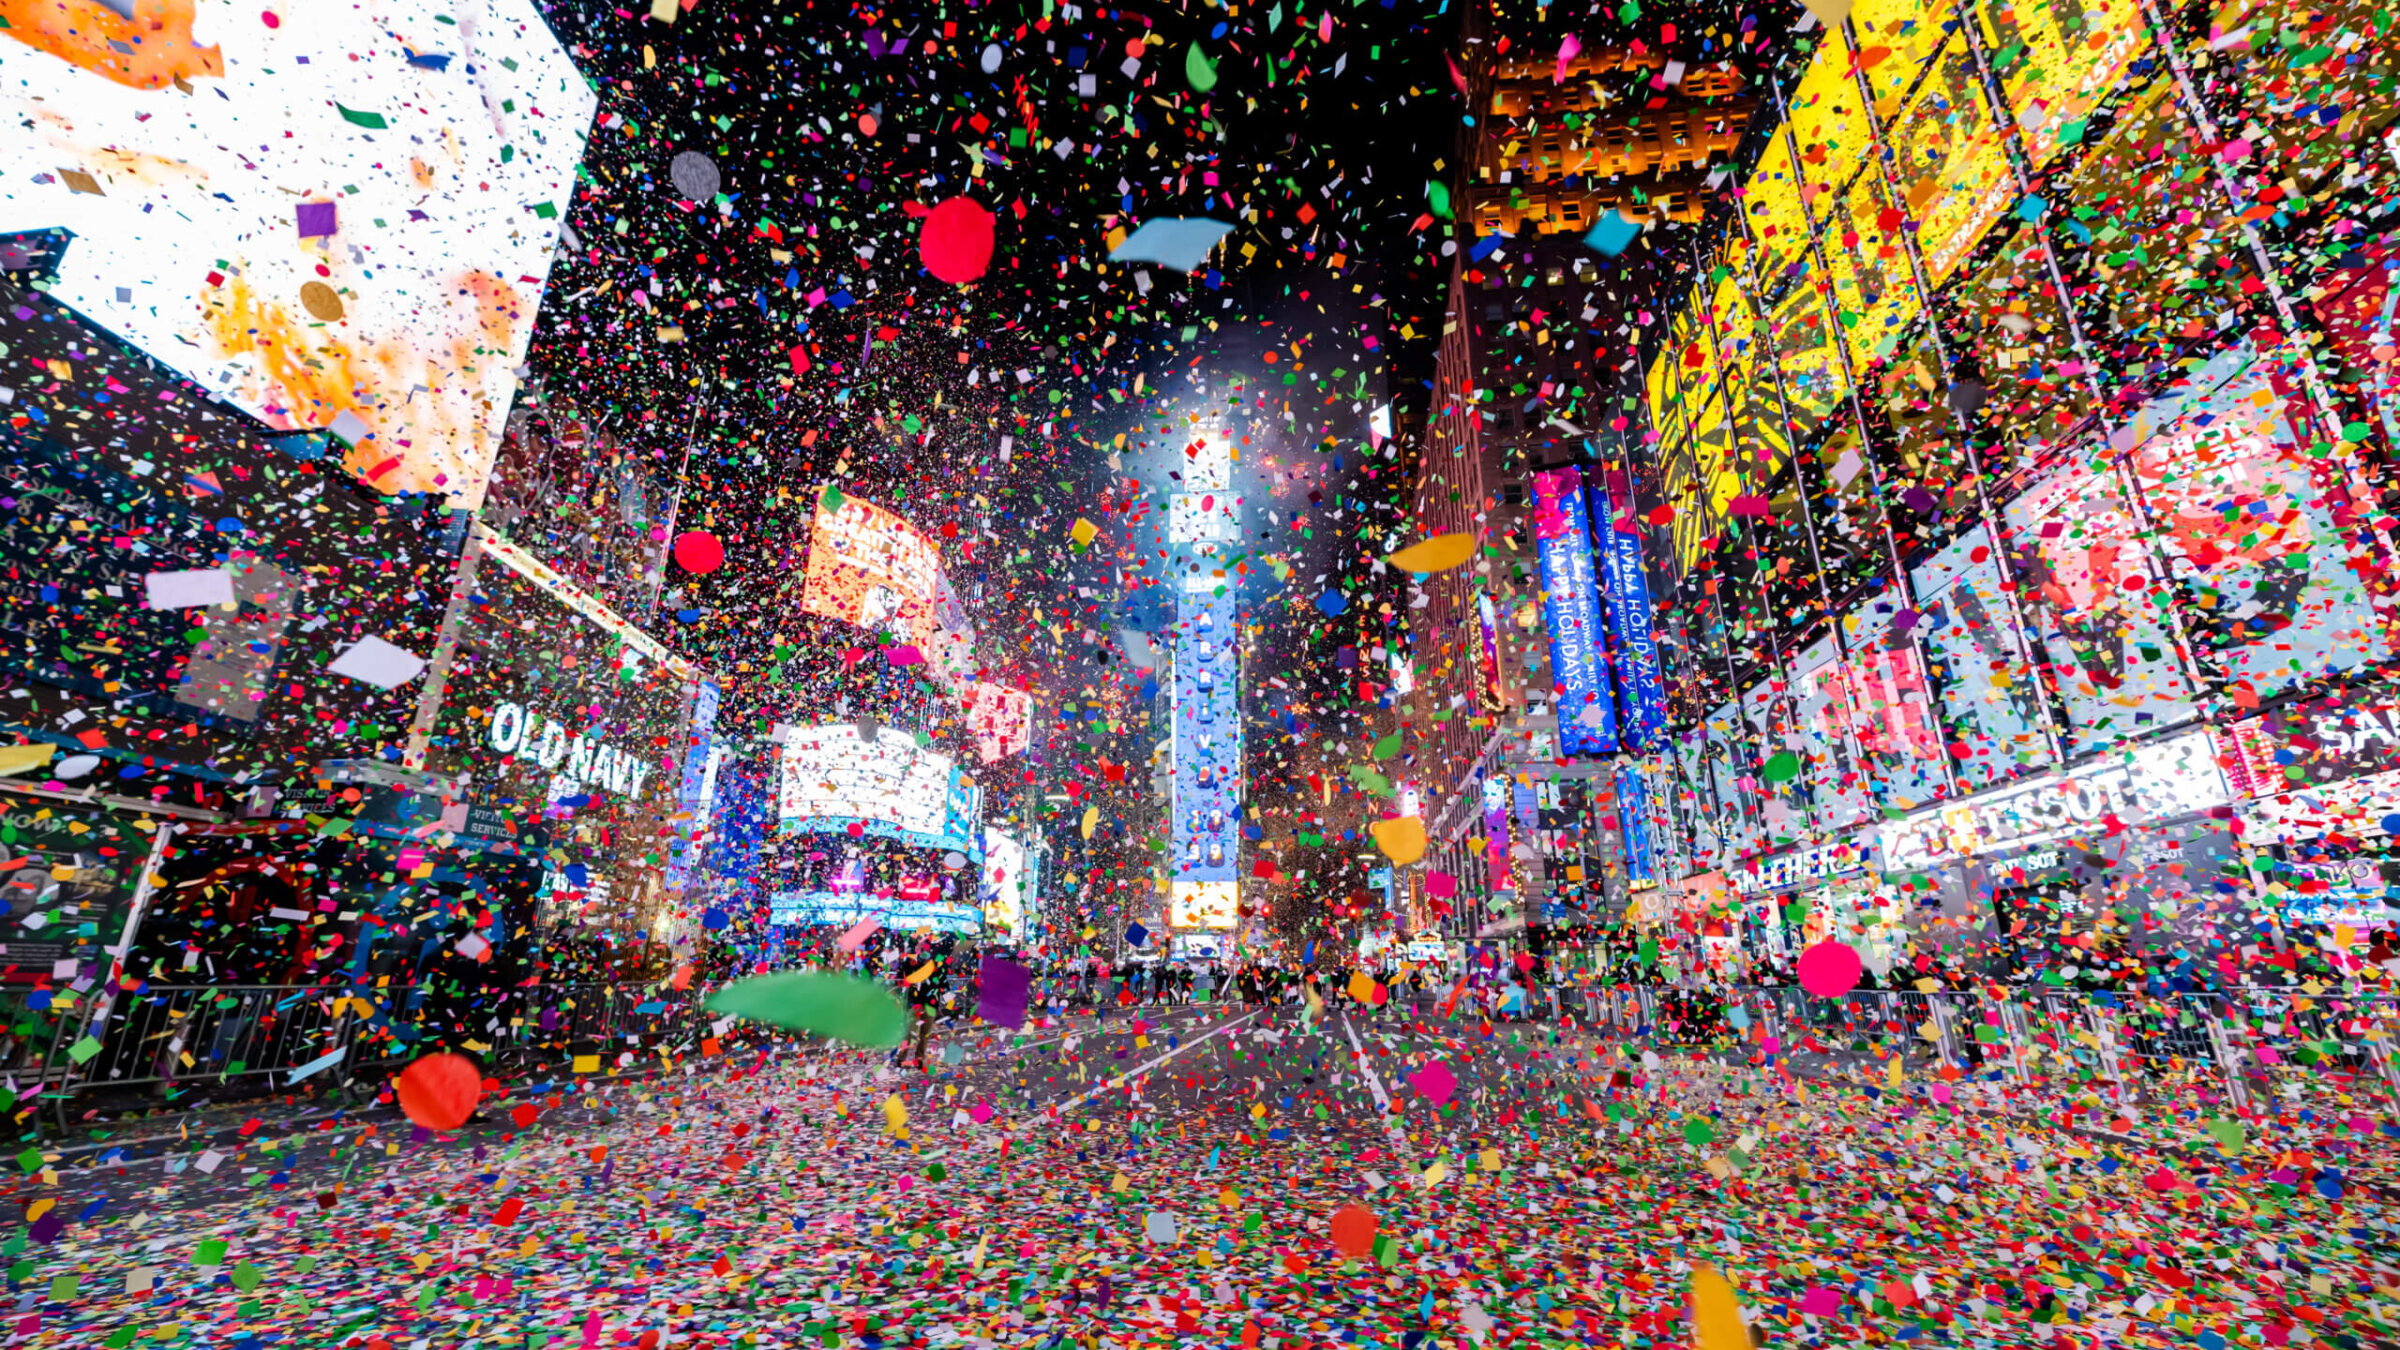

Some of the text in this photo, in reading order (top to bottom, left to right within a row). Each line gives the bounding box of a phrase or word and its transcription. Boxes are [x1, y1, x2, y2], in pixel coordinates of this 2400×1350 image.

[1548, 540, 1572, 600] HAPPY
[491, 702, 651, 801] OLD NAVY
